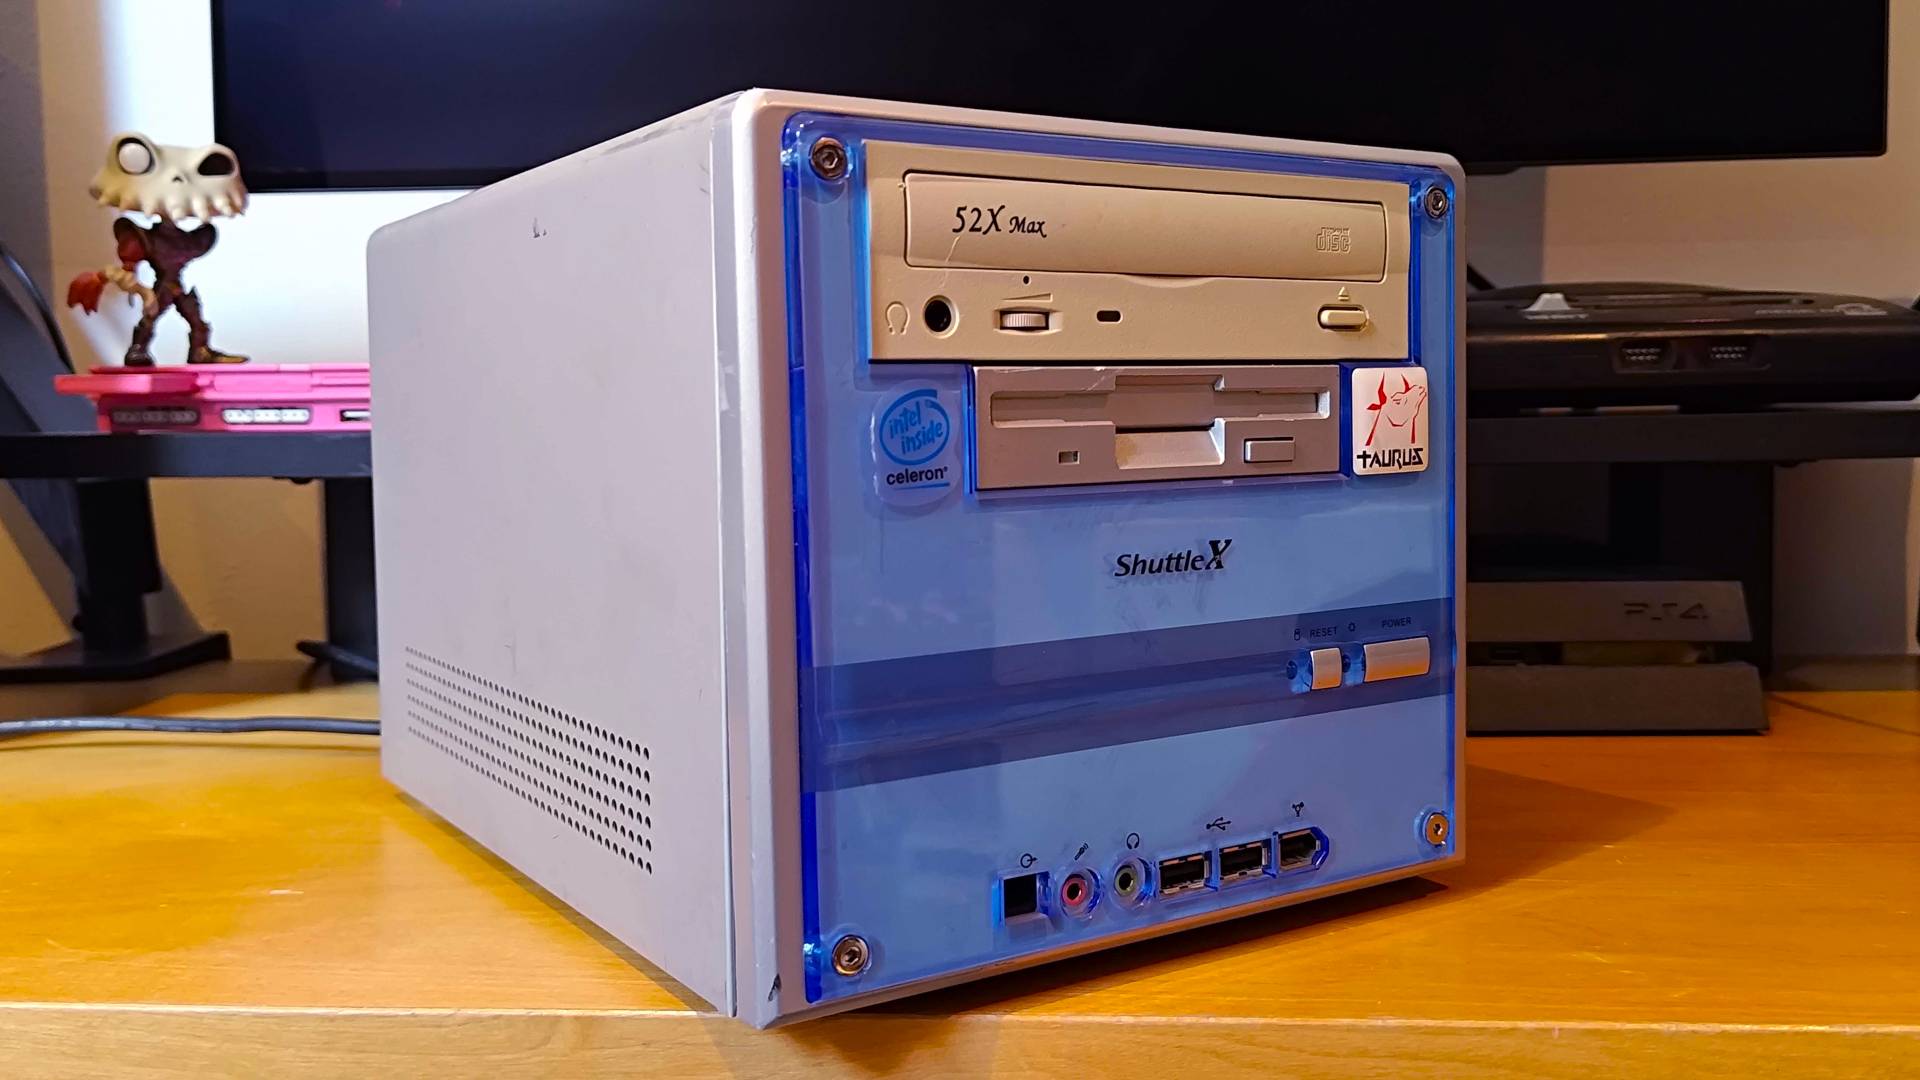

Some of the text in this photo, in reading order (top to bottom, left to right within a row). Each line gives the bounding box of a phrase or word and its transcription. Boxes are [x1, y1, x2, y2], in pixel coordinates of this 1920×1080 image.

[952, 205, 1047, 238] 52X Max
[889, 401, 921, 439] intel
[901, 421, 943, 455] inside
[1382, 617, 1412, 628] POWER
[1623, 602, 1709, 621] PS4
[1310, 627, 1337, 638] RESET
